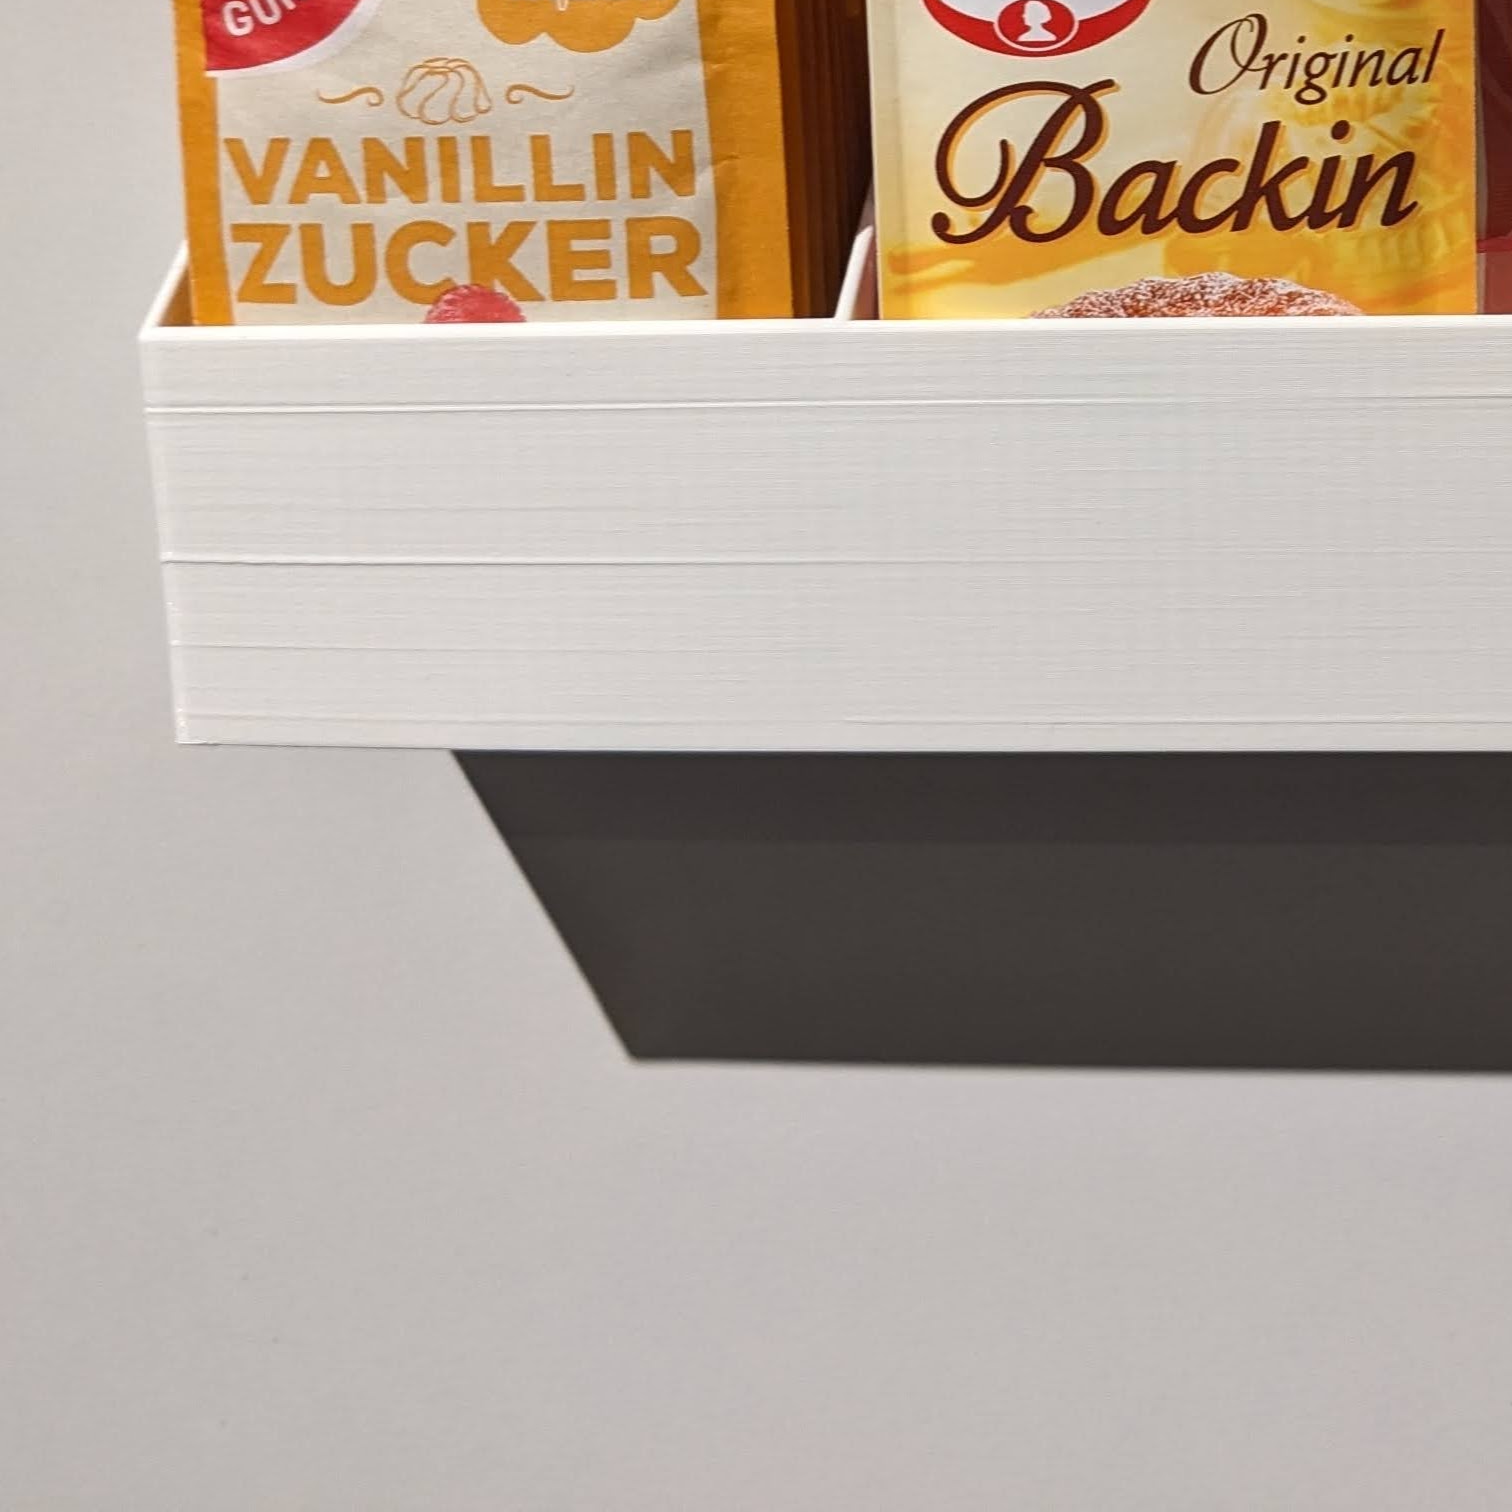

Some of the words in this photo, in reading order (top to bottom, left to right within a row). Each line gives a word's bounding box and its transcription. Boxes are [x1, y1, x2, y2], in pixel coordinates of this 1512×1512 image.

[1188, 12, 1445, 105] Original
[224, 129, 696, 207] VANILLIN
[930, 78, 1419, 245] Backin
[231, 216, 709, 306] ZUCKER
